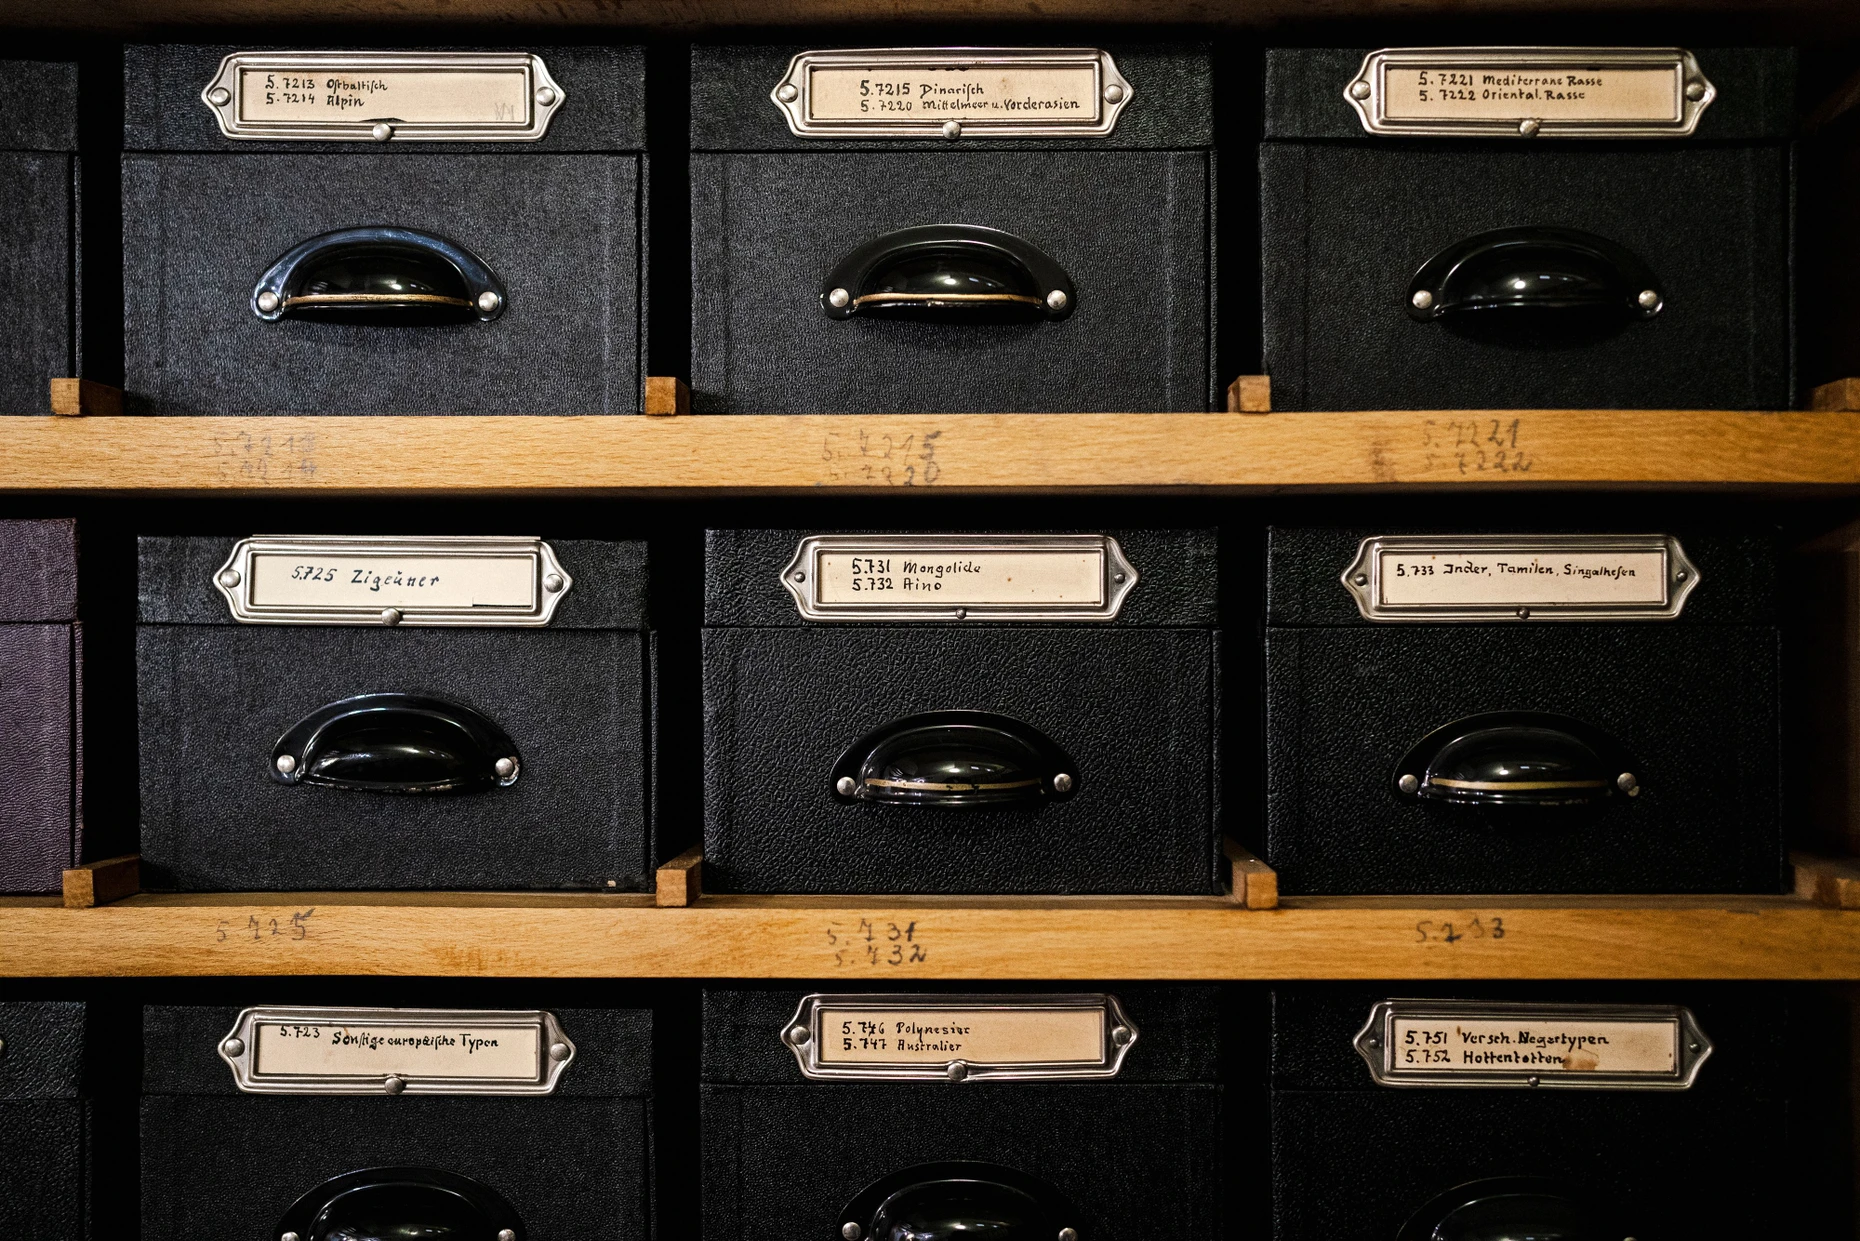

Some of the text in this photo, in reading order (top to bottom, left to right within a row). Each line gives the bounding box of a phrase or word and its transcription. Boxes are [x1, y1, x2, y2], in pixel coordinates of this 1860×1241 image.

[264, 72, 316, 90] 5.7213
[859, 79, 911, 97] 5.7215
[1566, 75, 1603, 88] Rasse
[265, 91, 316, 105] 5.7214
[1544, 89, 1586, 101] Rasse
[860, 98, 913, 113] 5.7220
[291, 565, 338, 583] 5.725
[851, 557, 981, 580] 5.731 Mongolide
[851, 576, 943, 592] 5.732 Aino
[279, 1025, 323, 1039] 5.723
[458, 1033, 499, 1055] Typen
[1404, 1029, 1448, 1047] 5.751
[1404, 1048, 1452, 1064] 5.752
